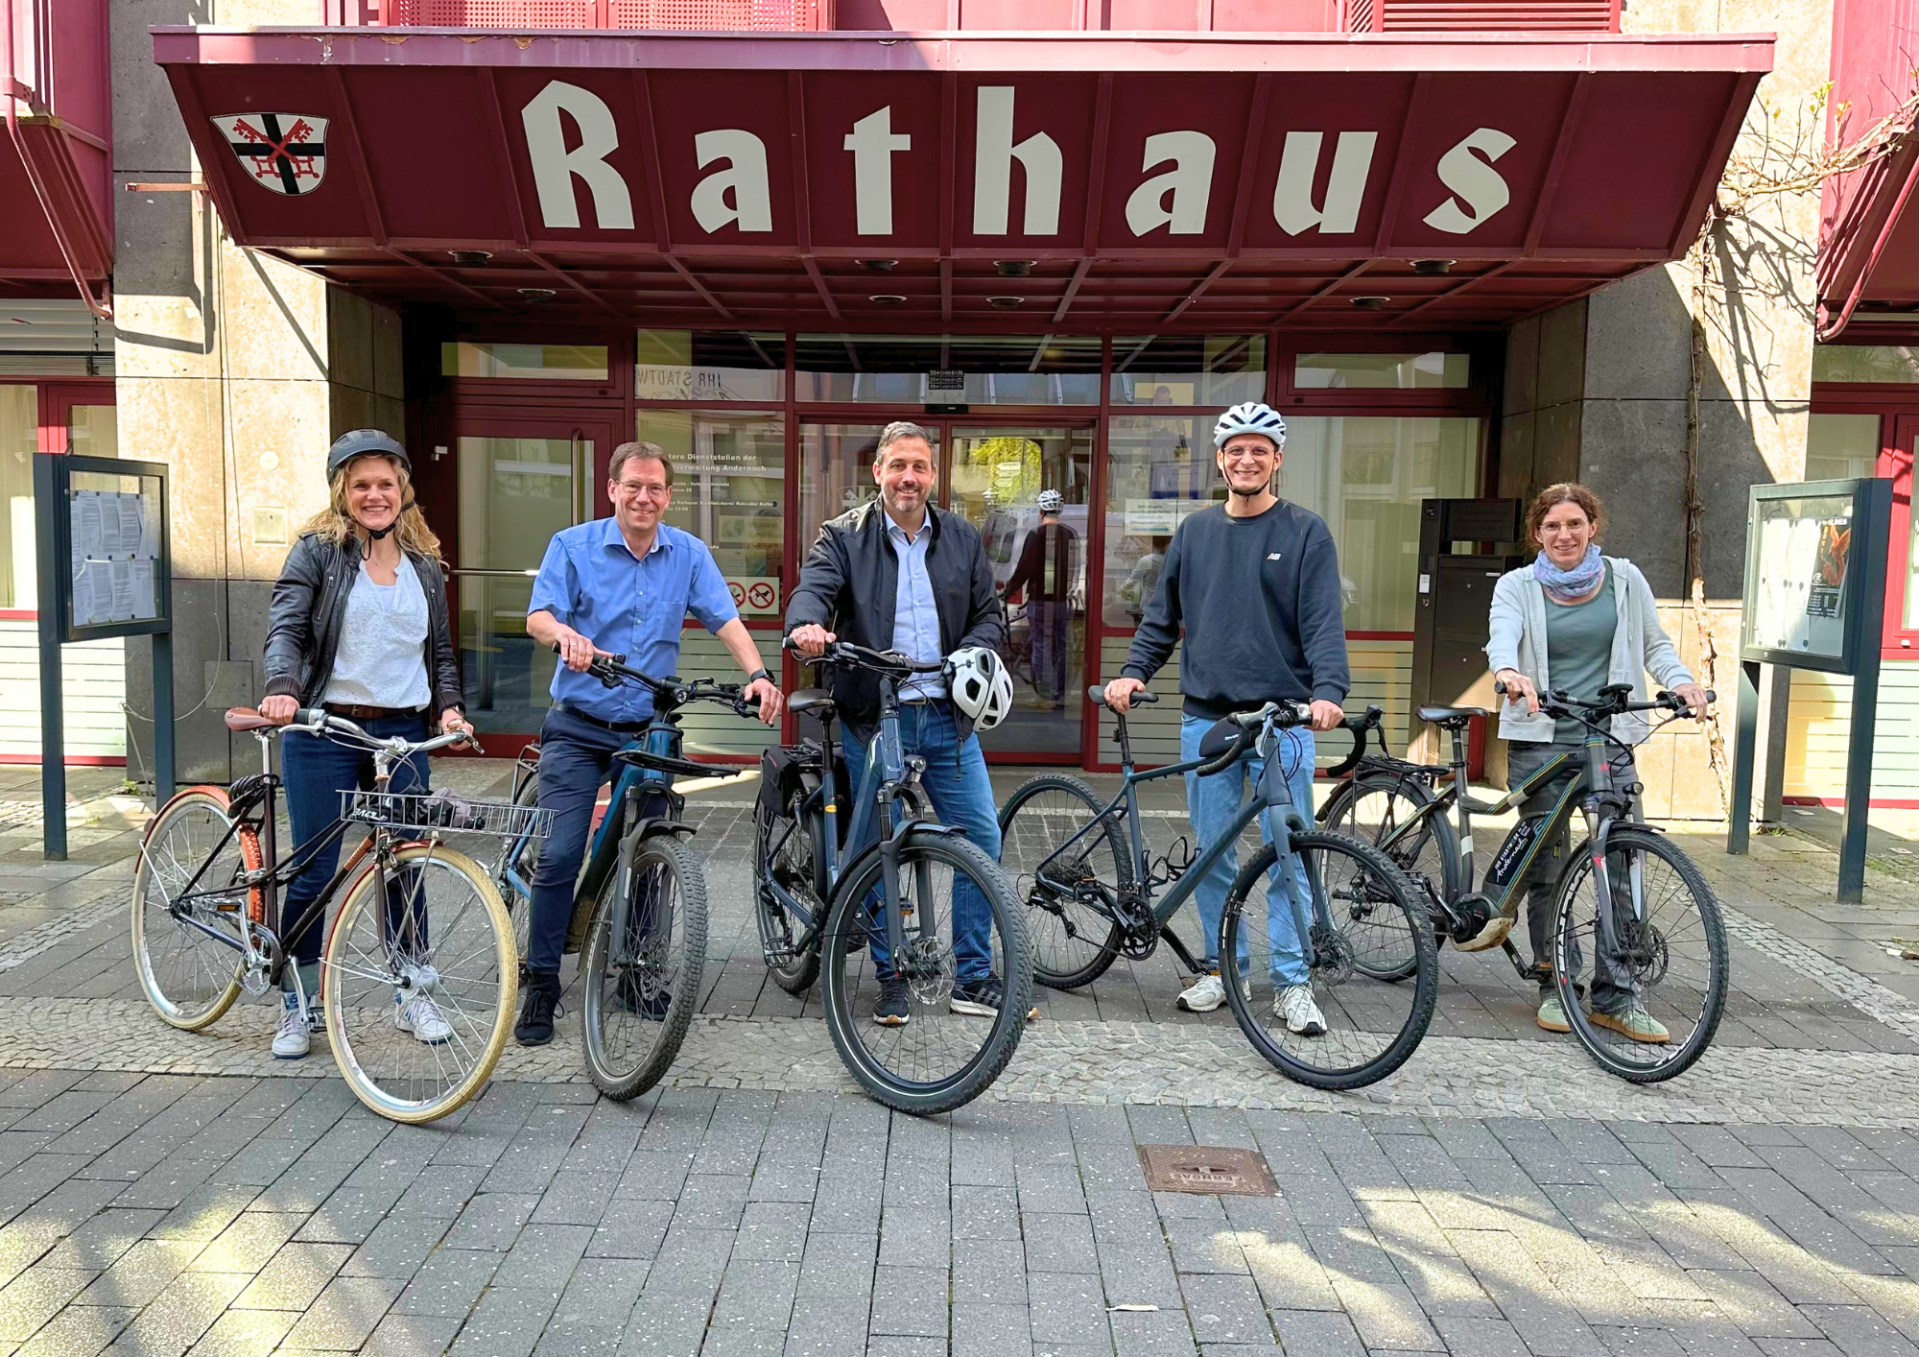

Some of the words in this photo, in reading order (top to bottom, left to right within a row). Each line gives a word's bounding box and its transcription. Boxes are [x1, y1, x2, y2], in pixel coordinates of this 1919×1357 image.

[521, 79, 1517, 238] Rathaus
[687, 453, 741, 461] Dienststellen
[722, 464, 766, 472] Andernach
